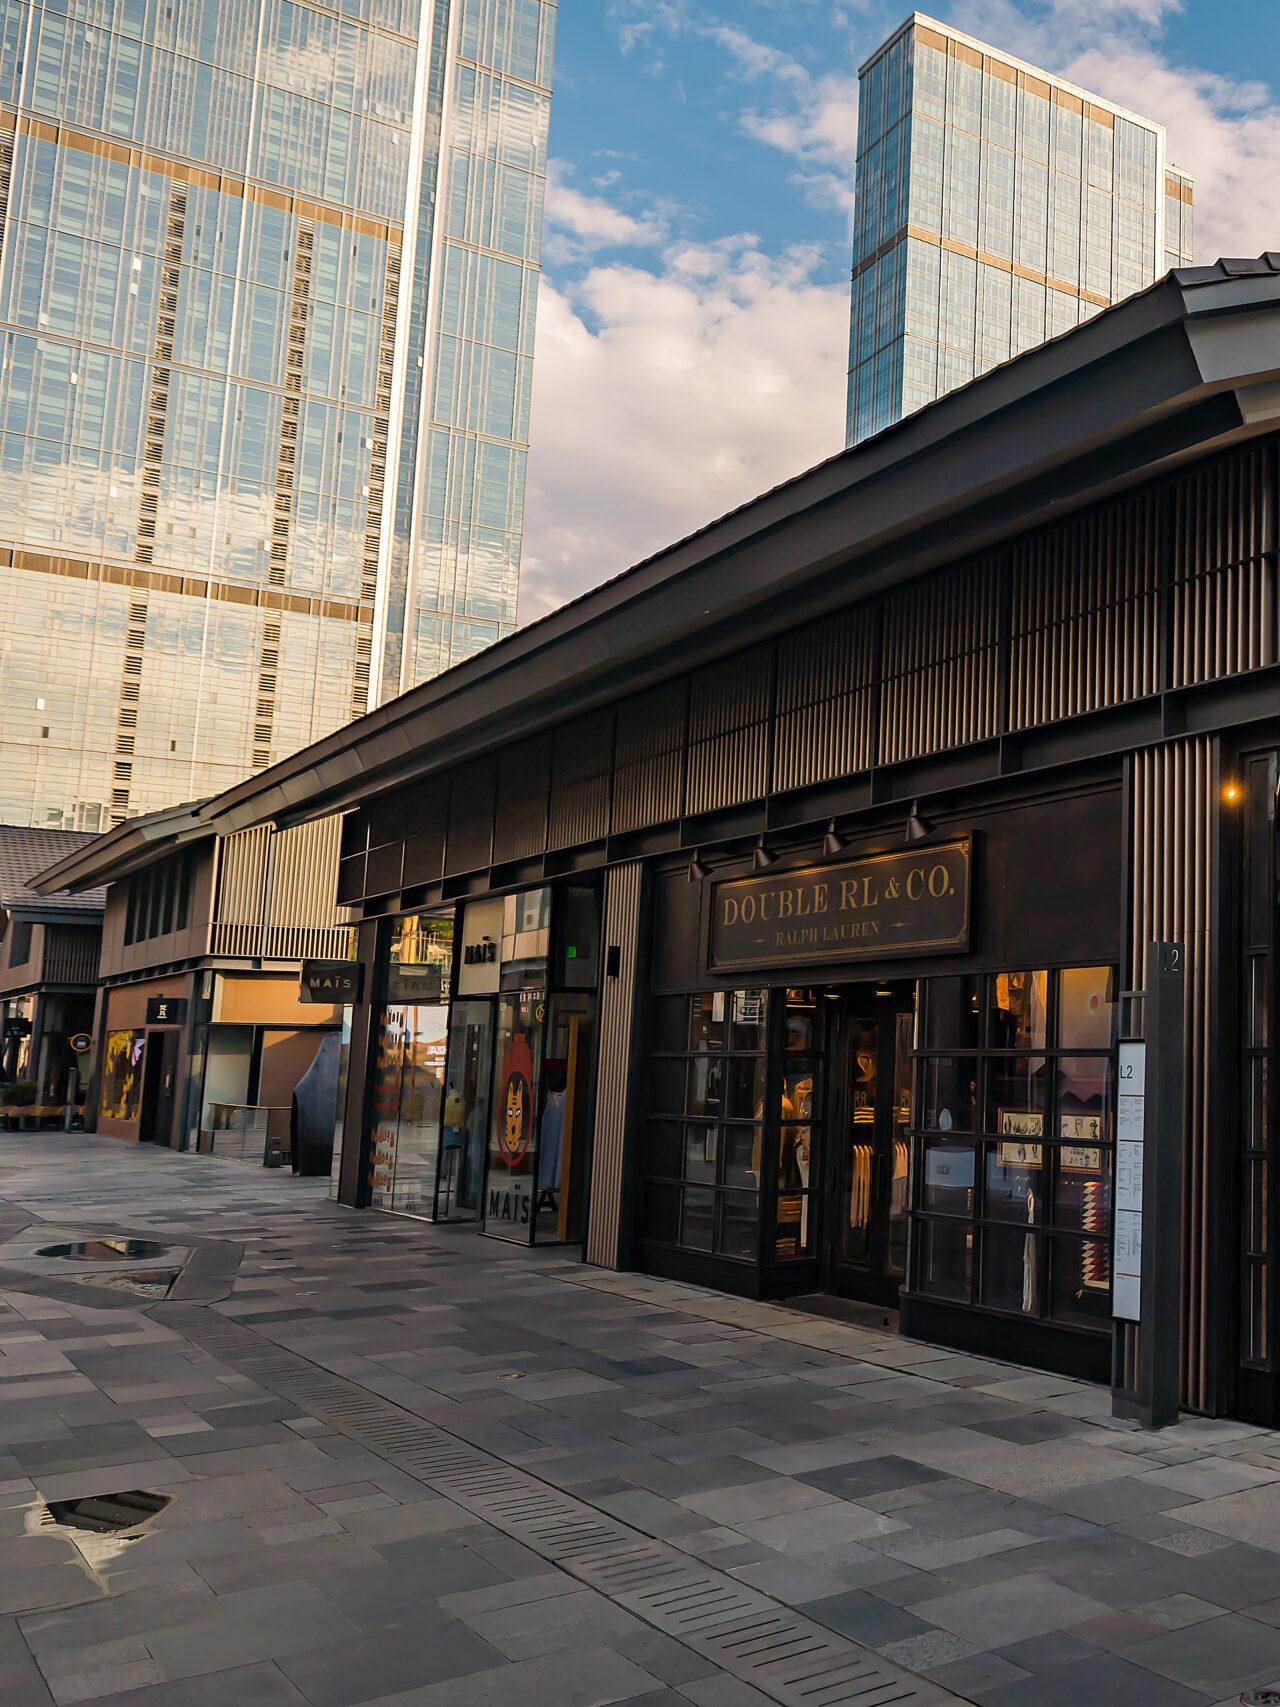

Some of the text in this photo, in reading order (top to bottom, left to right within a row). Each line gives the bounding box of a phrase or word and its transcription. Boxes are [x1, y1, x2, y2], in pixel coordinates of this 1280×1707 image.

[723, 884, 828, 926] DOUBLE
[839, 876, 878, 911] RL
[775, 920, 880, 946] RALPH LAUREN
[310, 976, 351, 989] MAÏS
[1120, 1065, 1133, 1079] L2
